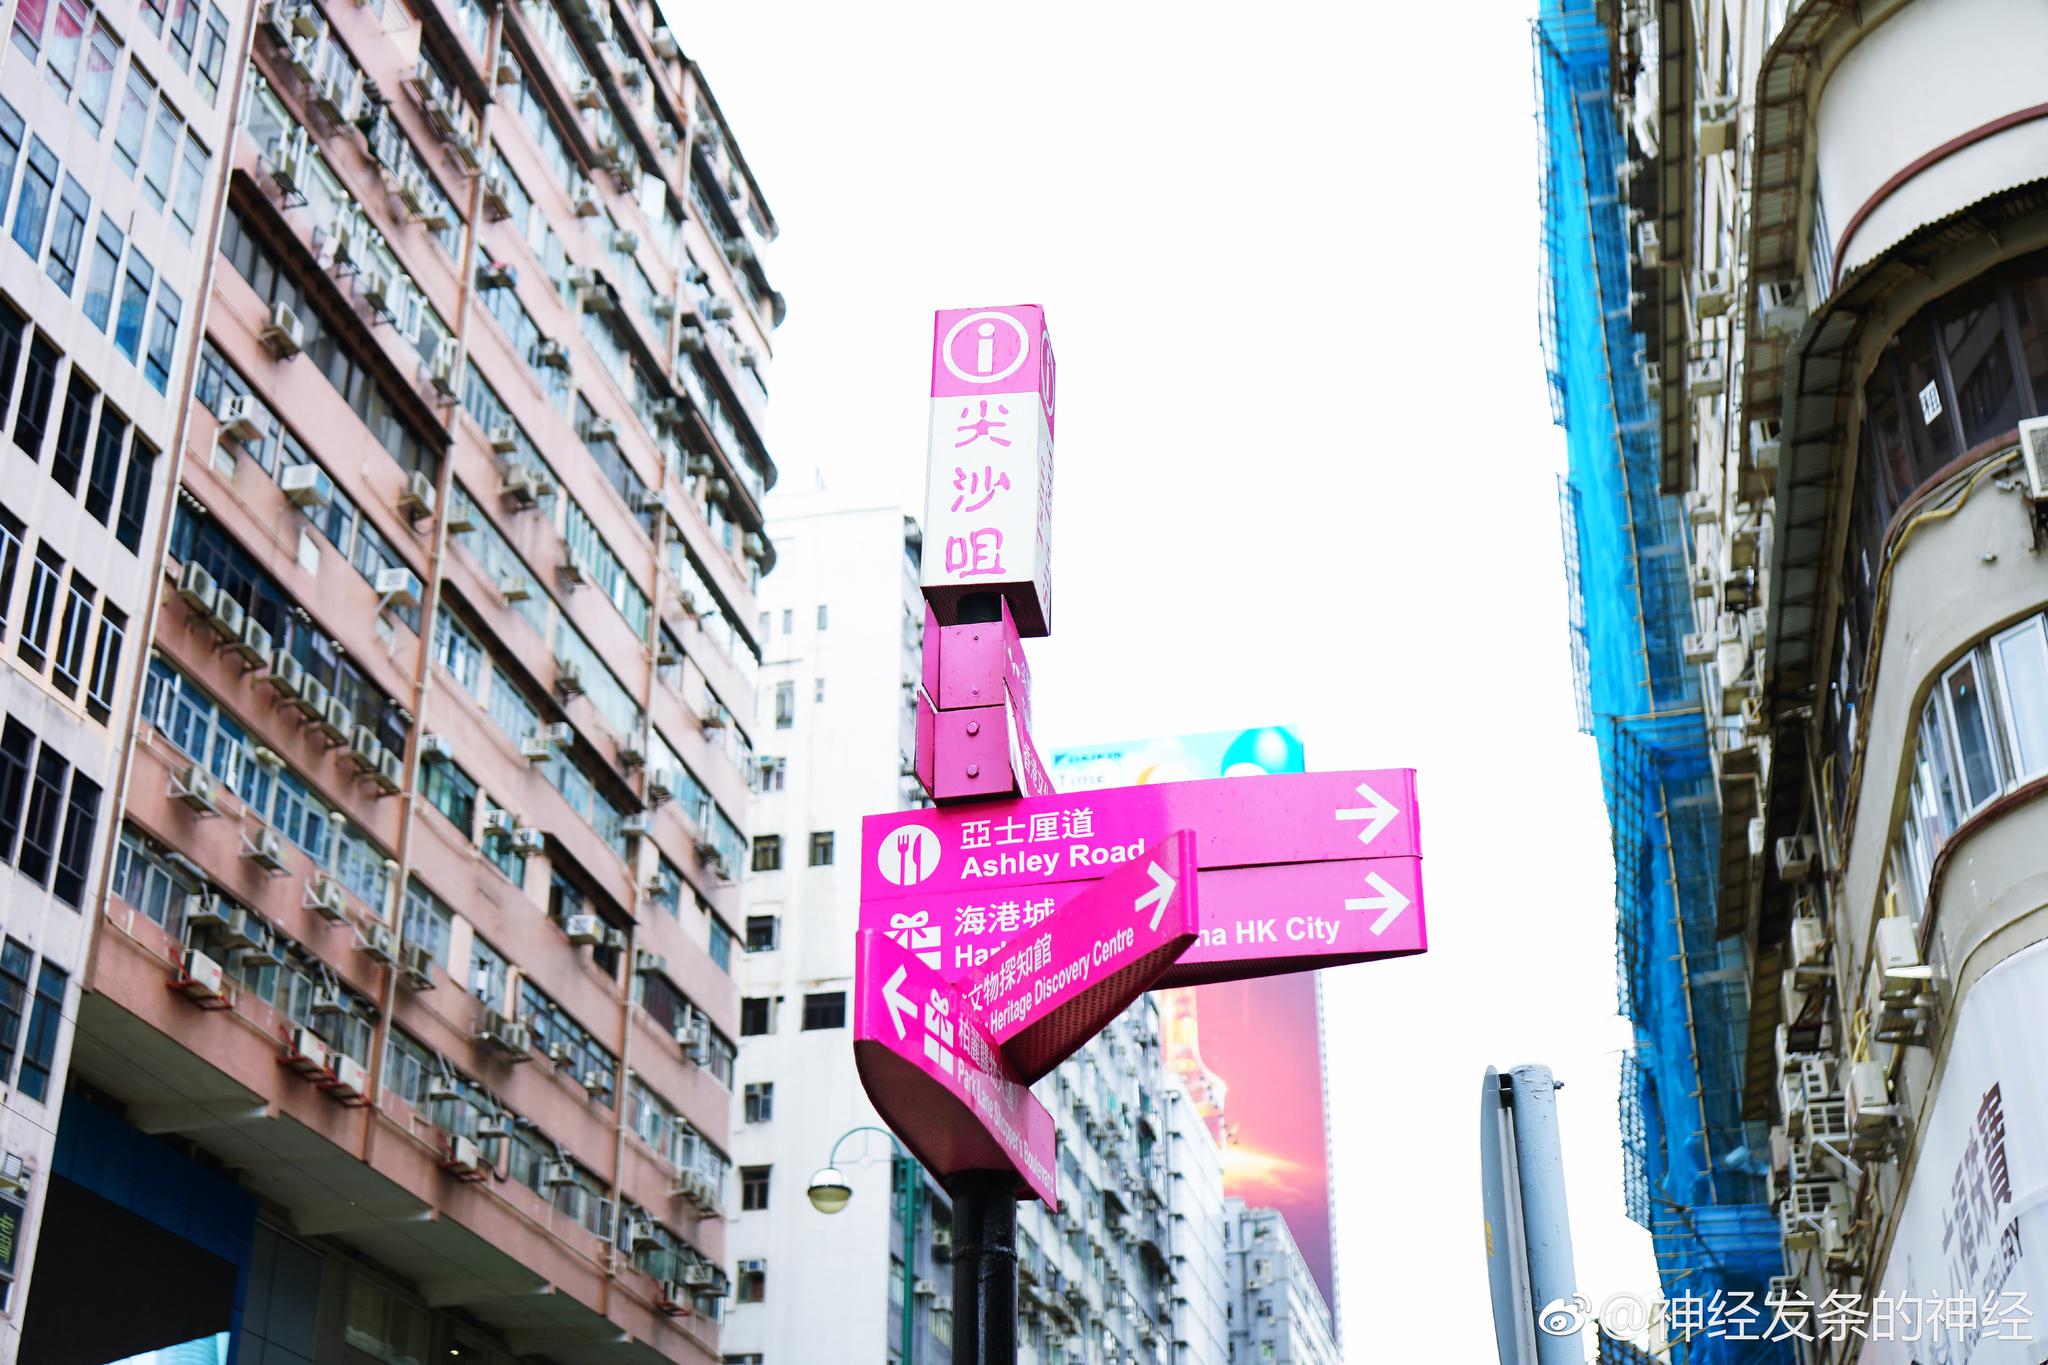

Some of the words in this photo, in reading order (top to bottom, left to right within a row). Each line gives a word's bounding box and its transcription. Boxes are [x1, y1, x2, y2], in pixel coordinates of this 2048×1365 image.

[945, 400, 1011, 579] 尖沙咀
[960, 806, 1095, 850] 亞士厘道
[960, 850, 1060, 880] Ashley
[1070, 838, 1146, 868] Road
[954, 898, 1056, 937] 海港城
[955, 939, 1007, 970] Har
[1235, 918, 1279, 945] HK
[1285, 916, 1341, 945] City
[963, 933, 1053, 1012] 文物探知館
[990, 994, 1033, 1035] Heritage
[1034, 952, 1091, 1007] Discovery
[1093, 926, 1135, 967] Centre
[957, 1058, 976, 1099] Park
[977, 1079, 994, 1119] Lane
[1023, 1139, 1054, 1195] Boulevard
